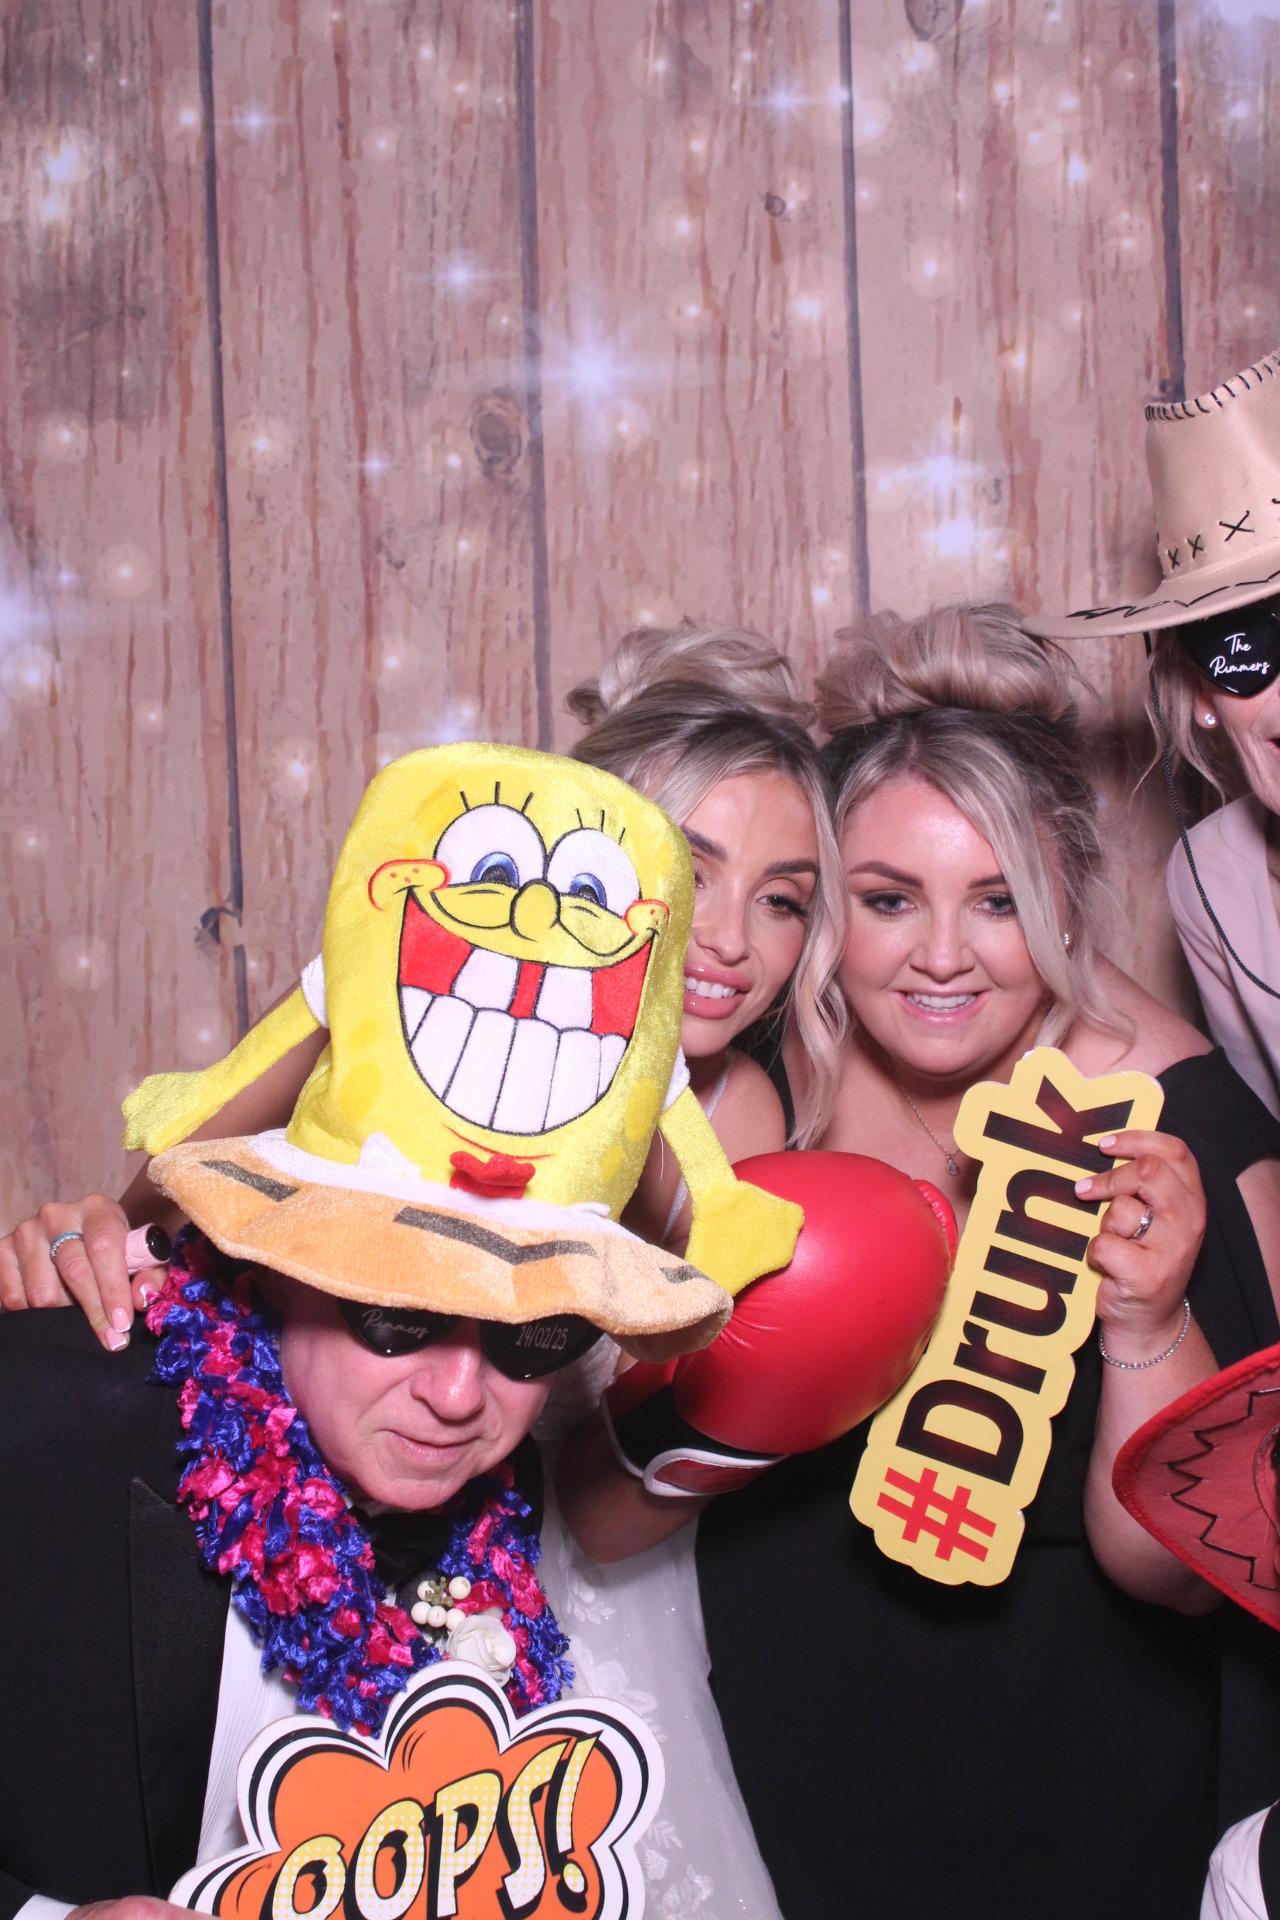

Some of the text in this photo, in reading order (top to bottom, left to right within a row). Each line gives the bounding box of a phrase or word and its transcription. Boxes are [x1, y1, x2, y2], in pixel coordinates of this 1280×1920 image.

[1224, 633, 1252, 655] The
[1209, 655, 1271, 677] Rimmers
[876, 1074, 1135, 1562] #Drunk
[515, 1322, 569, 1350] 14/02/25
[266, 1729, 604, 1920] OOPS!
